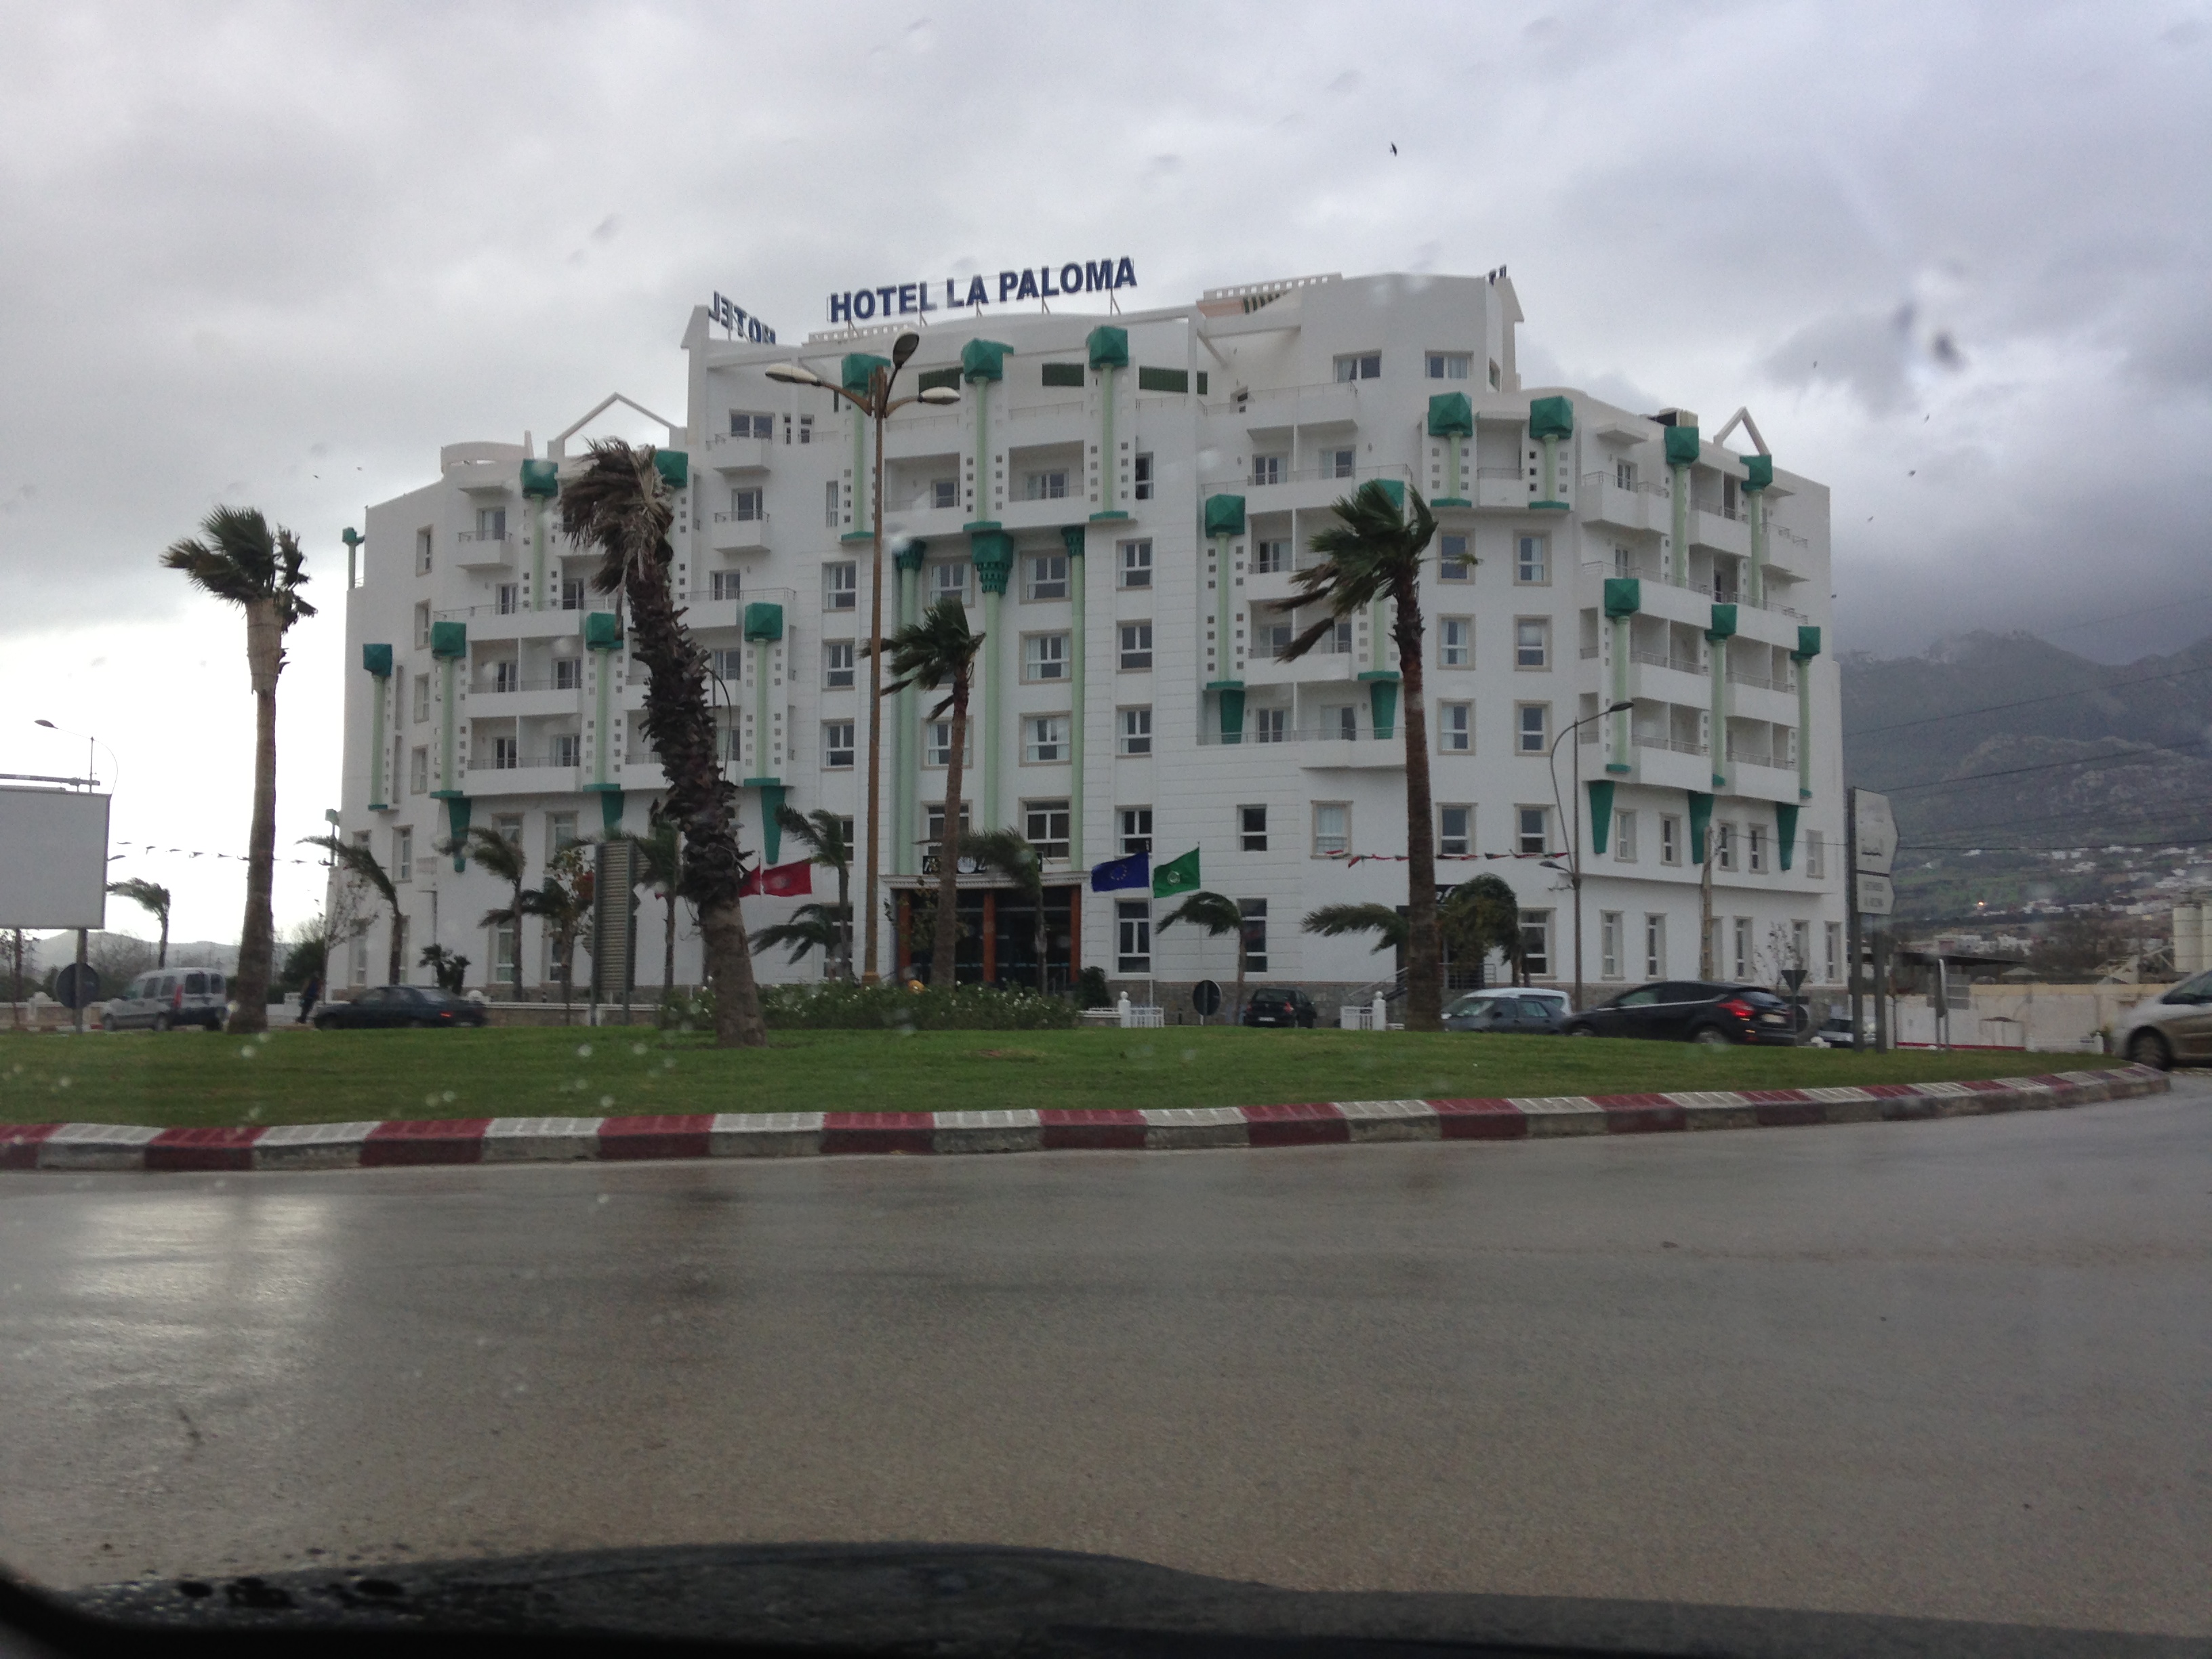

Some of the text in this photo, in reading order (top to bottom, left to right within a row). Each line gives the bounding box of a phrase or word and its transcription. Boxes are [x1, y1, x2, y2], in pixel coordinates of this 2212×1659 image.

[831, 255, 1137, 322] HOTEL LA PALOMA
